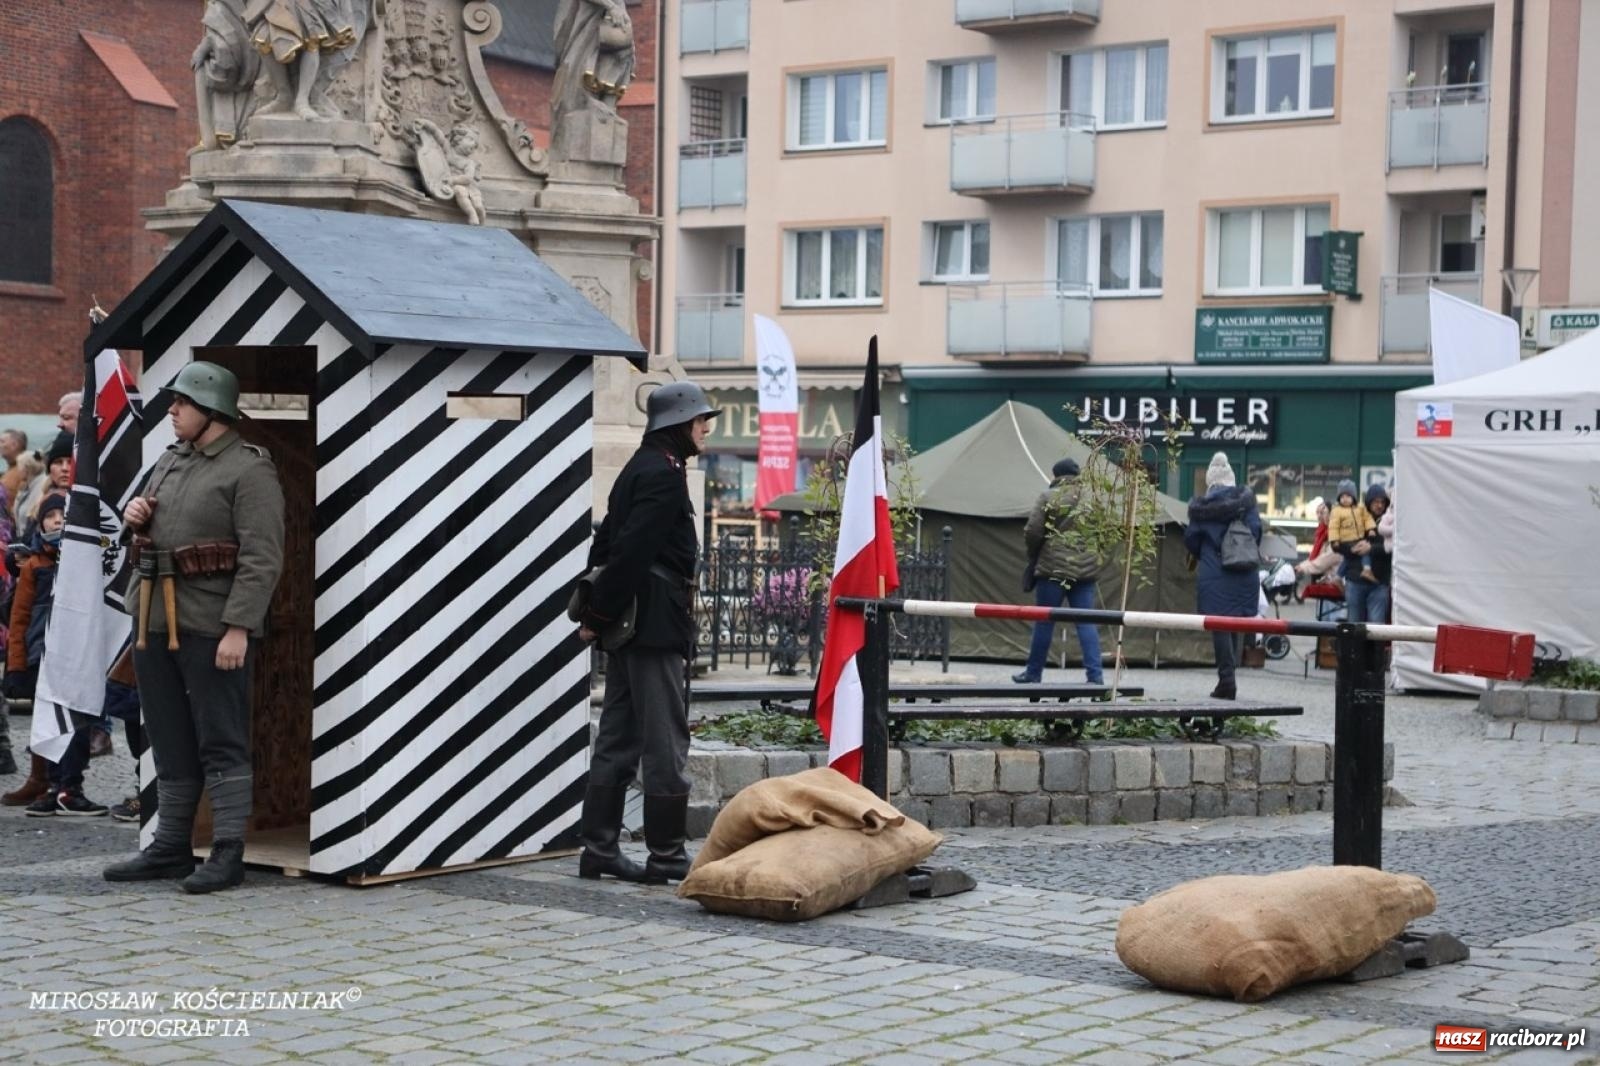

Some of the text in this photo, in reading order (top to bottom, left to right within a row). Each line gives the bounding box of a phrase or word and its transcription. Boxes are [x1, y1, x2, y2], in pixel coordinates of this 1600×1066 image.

[1218, 314, 1323, 327] KANCELARIE ADWOKACKIE
[1566, 315, 1597, 326] KASA
[1077, 396, 1270, 425] JUBILER
[1484, 408, 1563, 432] GRH
